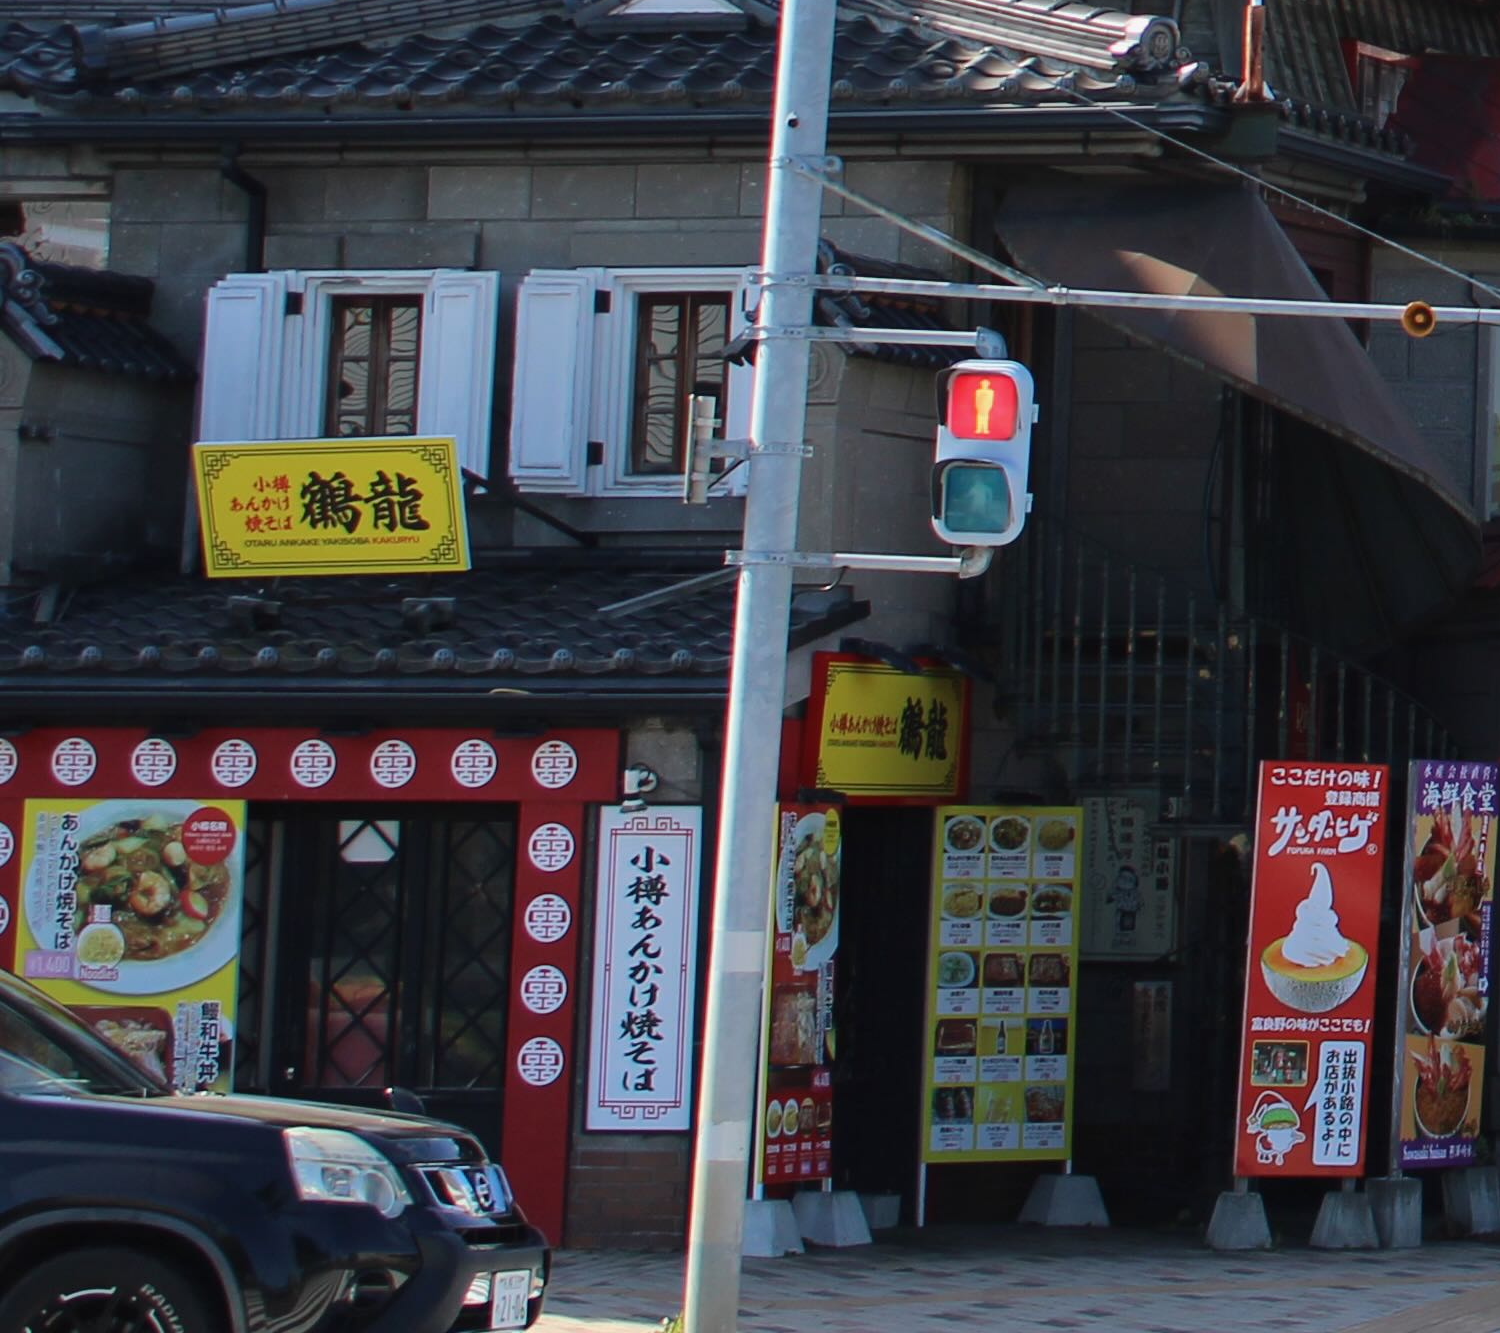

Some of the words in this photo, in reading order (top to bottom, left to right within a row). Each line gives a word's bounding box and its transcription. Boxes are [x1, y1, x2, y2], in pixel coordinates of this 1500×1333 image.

[254, 475, 291, 493] 小樽
[230, 497, 290, 512] あんかけ
[245, 516, 293, 533] 焼そば
[244, 539, 277, 548] OTARU
[279, 538, 320, 547] ANKAKE
[322, 537, 370, 546] YAKISOBA
[372, 536, 420, 545] KAKURYU
[1422, 782, 1497, 812] 海鮮食堂
[55, 813, 80, 950] あんかけ焼そば
[79, 966, 118, 981] Noodles
[619, 846, 670, 1093] 小樽あんかけ焼そば
[1337, 1049, 1357, 1157] 出抜小路の中に
